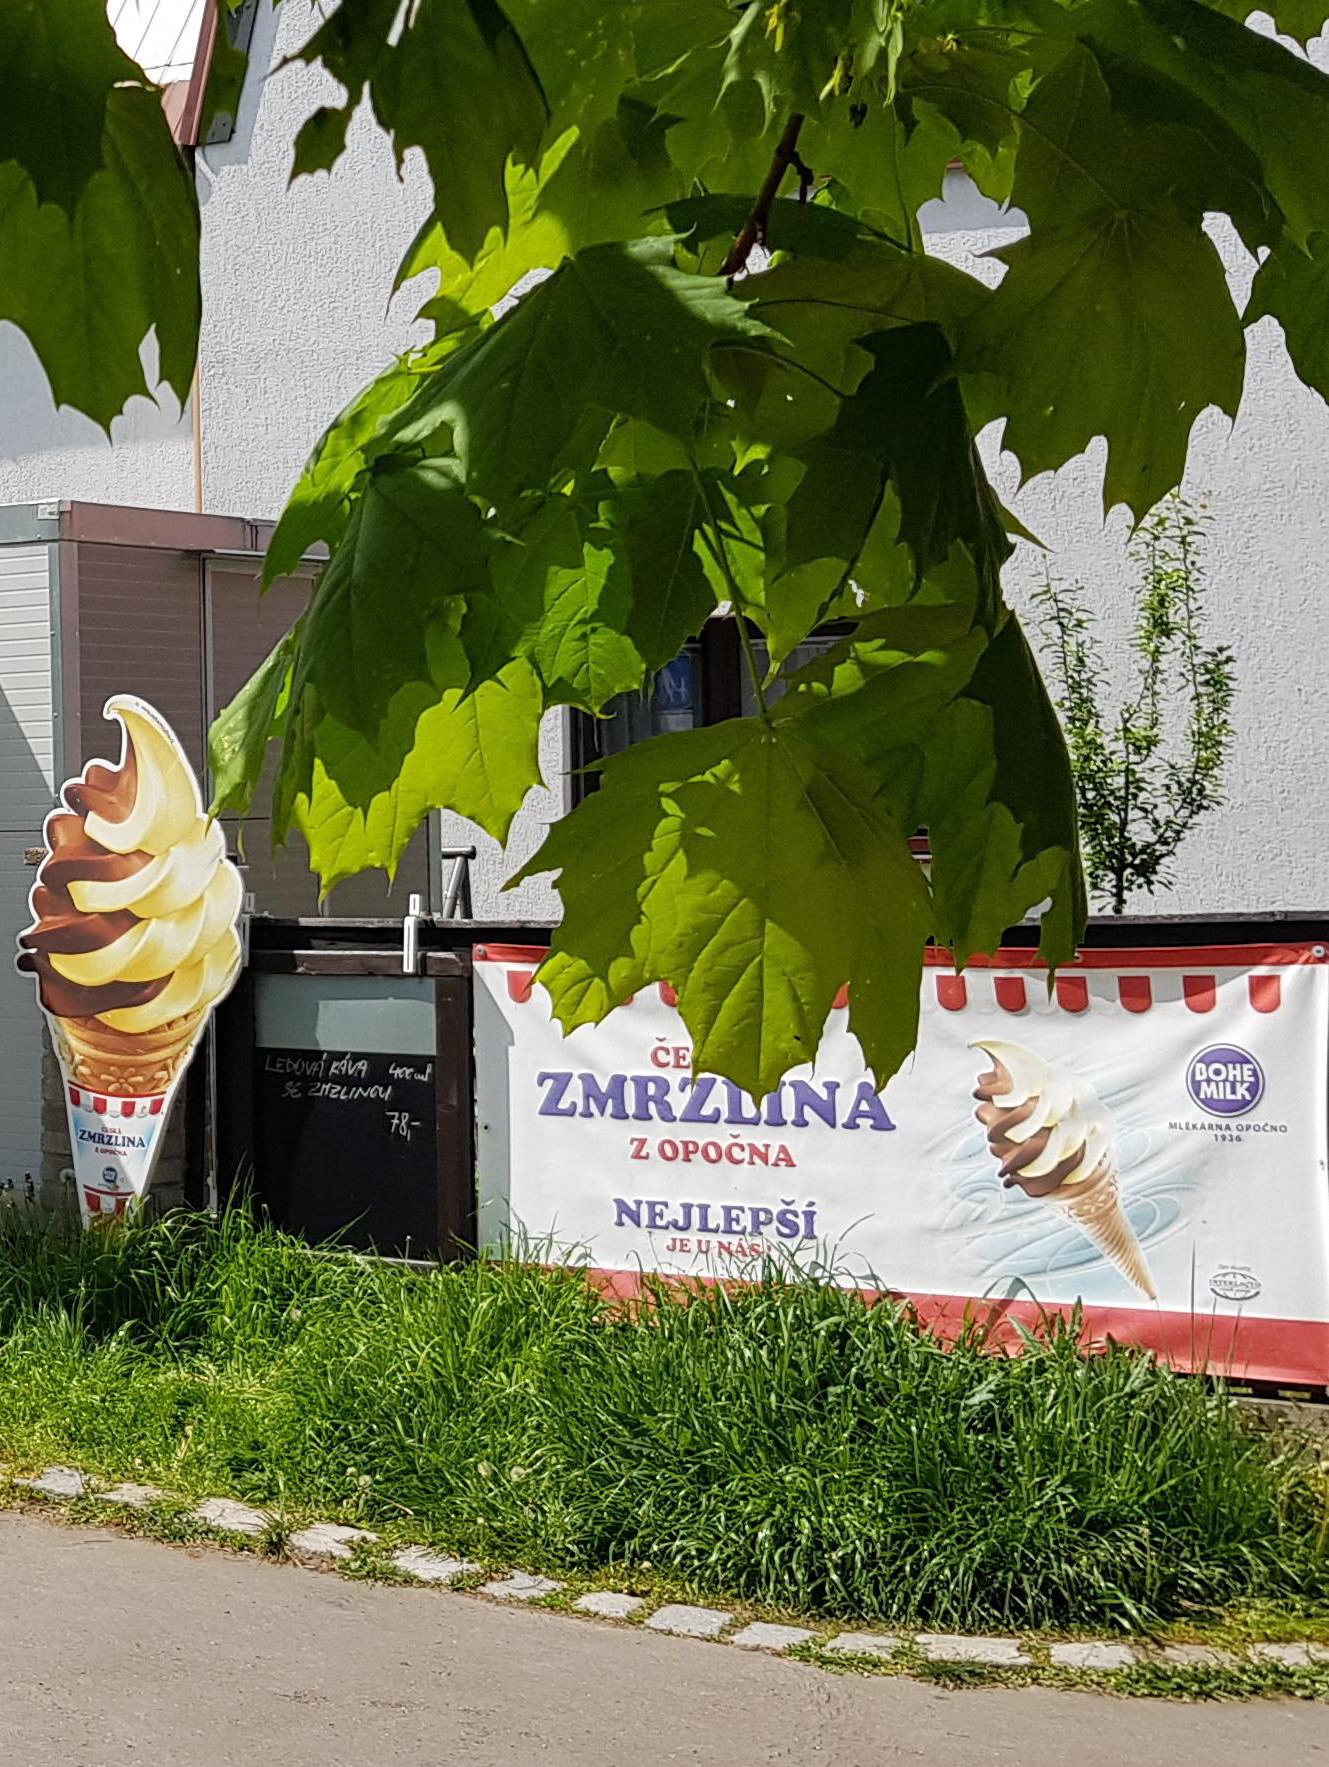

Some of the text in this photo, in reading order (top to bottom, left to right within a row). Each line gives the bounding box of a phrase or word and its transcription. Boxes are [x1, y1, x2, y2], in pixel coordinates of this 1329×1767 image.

[265, 1053, 327, 1078] LEDOVÁ
[328, 1053, 368, 1078] KÁVA
[1195, 1062, 1254, 1081] BOHE
[281, 1081, 302, 1098] SE
[1199, 1082, 1252, 1100] MILK
[536, 1071, 896, 1131] ZMRZLINA
[1235, 1122, 1288, 1133] OPOČNO
[79, 1128, 146, 1148] ZMRZLINA
[1213, 1133, 1243, 1142] 1936
[630, 1134, 797, 1167] Z OPOČNA
[613, 1198, 817, 1240] NEJLEPŠÍ
[666, 1237, 691, 1253] JE
[695, 1238, 712, 1254] U
